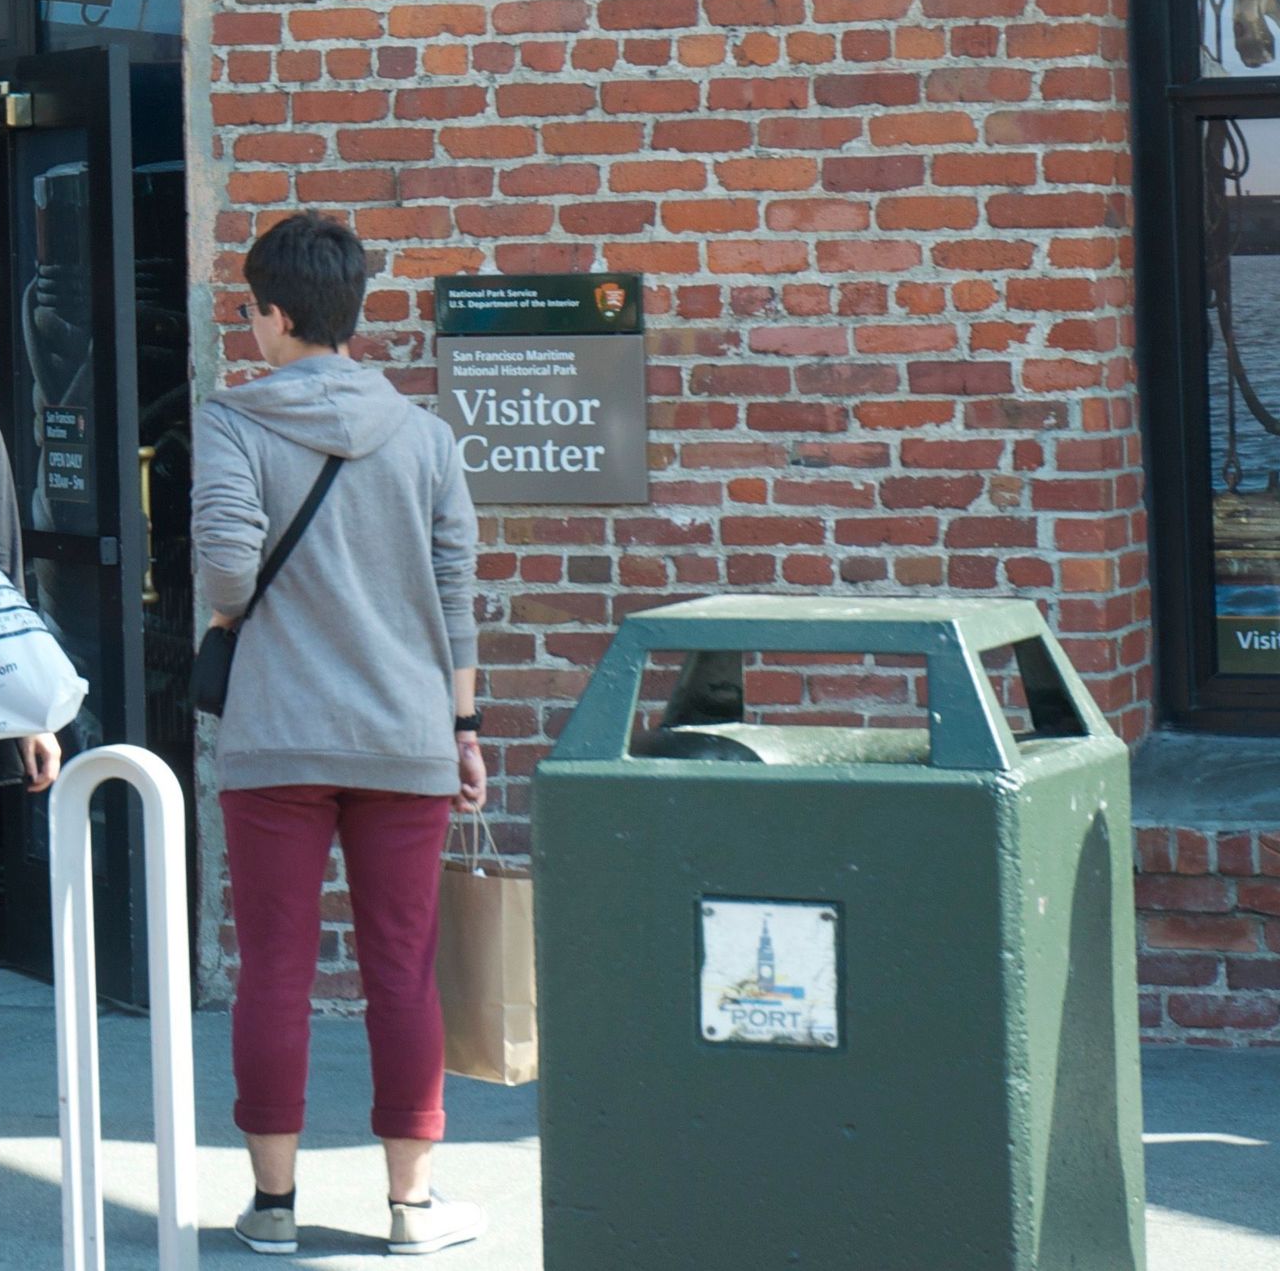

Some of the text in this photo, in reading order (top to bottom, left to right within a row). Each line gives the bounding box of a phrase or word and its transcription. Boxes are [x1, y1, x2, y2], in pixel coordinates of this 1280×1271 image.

[448, 288, 538, 298] National Park Service
[448, 298, 580, 310] U.S. Department of the Interior
[452, 349, 576, 362] San Francisco Maritime
[452, 364, 578, 377] National Historical Park
[452, 388, 601, 426] Visitor
[458, 434, 606, 473] Center
[731, 1009, 803, 1029] PORT
